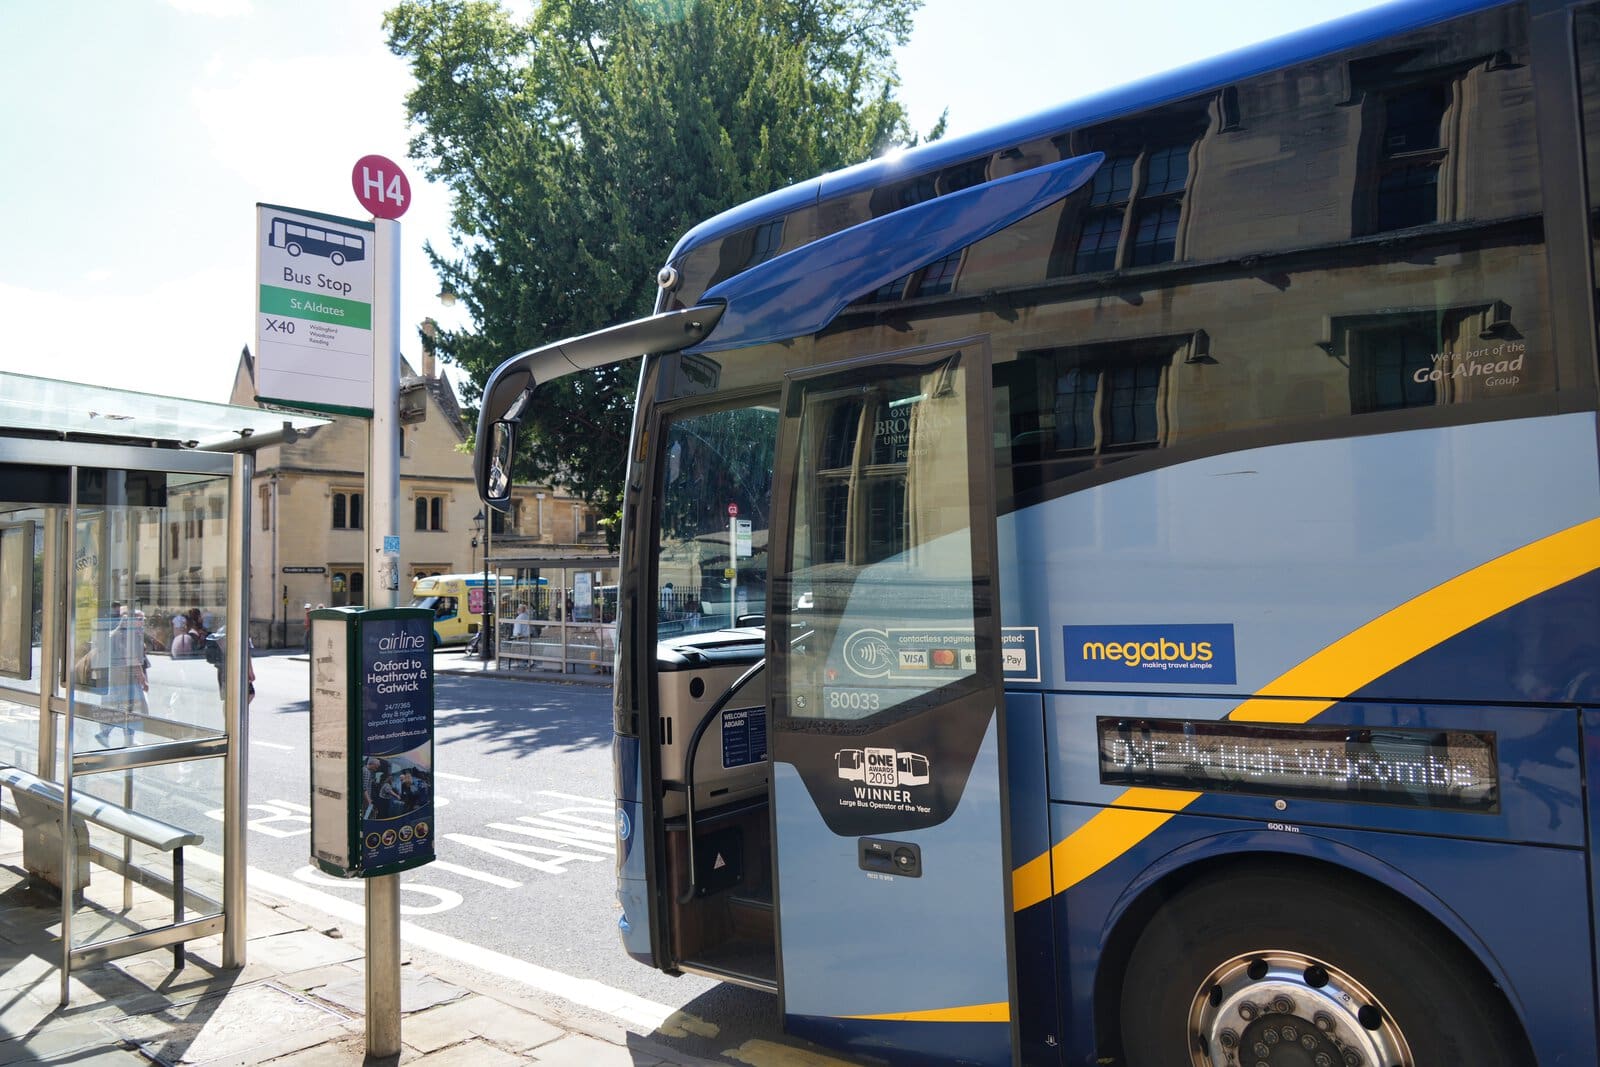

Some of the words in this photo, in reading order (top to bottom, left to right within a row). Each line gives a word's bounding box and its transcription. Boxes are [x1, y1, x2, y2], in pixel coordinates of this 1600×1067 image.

[363, 166, 404, 207] H4
[283, 267, 312, 286] Bus
[317, 274, 352, 296] Stop
[290, 298, 302, 310] St
[304, 300, 345, 317] Aldates
[265, 318, 296, 335] X40
[1430, 351, 1462, 363] We're
[1466, 348, 1489, 360] part
[1492, 343, 1505, 356] of
[1507, 342, 1525, 353] the
[1413, 354, 1524, 383] Go-Ahead
[1485, 375, 1520, 387] Group
[379, 630, 425, 650] airline
[899, 635, 942, 644] contactless
[943, 635, 975, 645] paymen
[1001, 634, 1025, 644] pted:
[903, 654, 925, 664] VISA
[1083, 638, 1213, 667] megabus
[373, 659, 409, 672] Oxford
[411, 660, 422, 669] to
[1007, 655, 1022, 665] Pay
[1142, 662, 1167, 670] making
[1189, 662, 1213, 670] simple
[367, 671, 418, 684] Heathrow
[419, 669, 427, 679] &
[376, 681, 419, 694] Gatwick
[830, 692, 879, 710] 80033
[724, 711, 748, 720] WELCOME
[367, 719, 388, 728] airport
[724, 720, 745, 728] ABOARD
[868, 754, 894, 767] ONE
[1113, 739, 1168, 769] OXF
[1220, 744, 1284, 776] High
[1294, 748, 1472, 787] Wycombe
[868, 772, 895, 785] 2019
[853, 786, 912, 803] WINNER
[839, 798, 857, 807] Large
[857, 800, 869, 808] Bus
[869, 801, 897, 810] Operator
[916, 805, 931, 813] Year
[1267, 822, 1284, 831] 600
[1284, 824, 1300, 833] Nm
